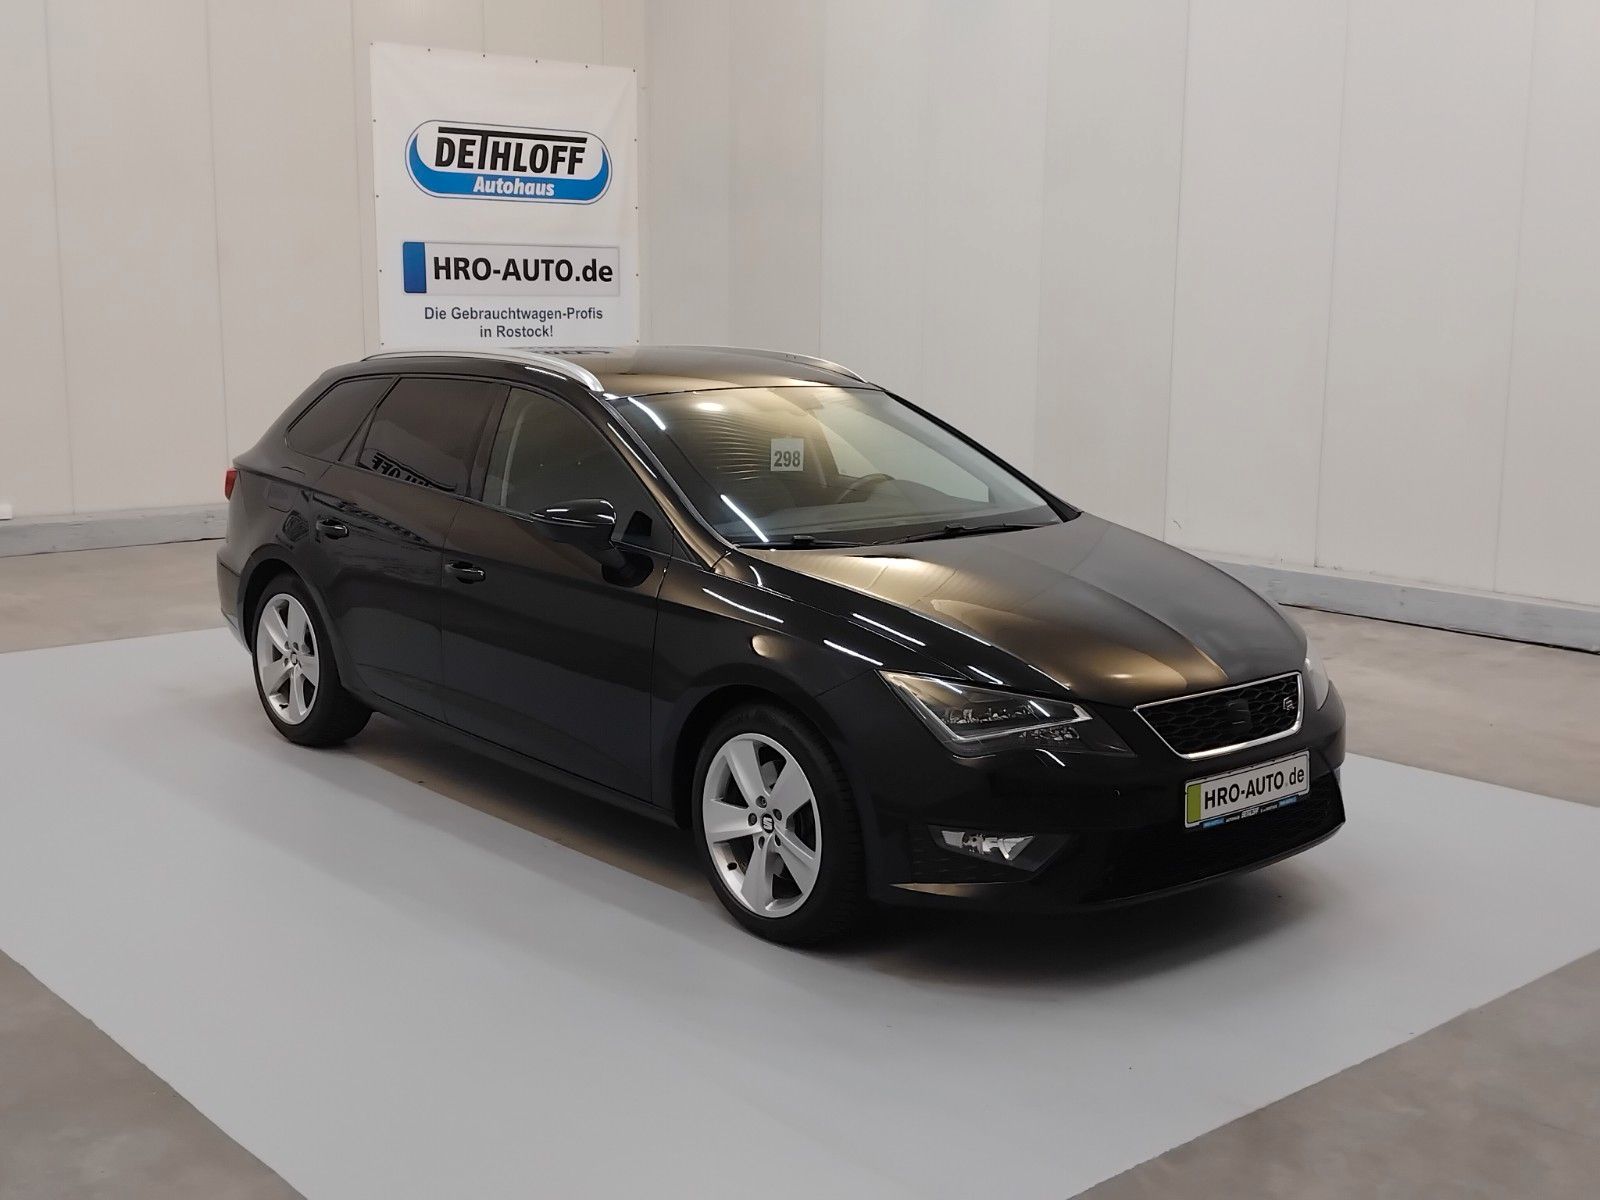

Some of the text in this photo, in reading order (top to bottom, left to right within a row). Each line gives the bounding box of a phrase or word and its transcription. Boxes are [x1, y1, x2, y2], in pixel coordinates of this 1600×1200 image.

[435, 126, 587, 175] DETHLOFF
[473, 175, 555, 196] Autohaus
[433, 256, 614, 283] HRO-AUTO.de
[424, 306, 603, 323] Die Gebrauchtwagen-Profis
[479, 324, 554, 338] in Rostock!
[773, 450, 801, 468] 298
